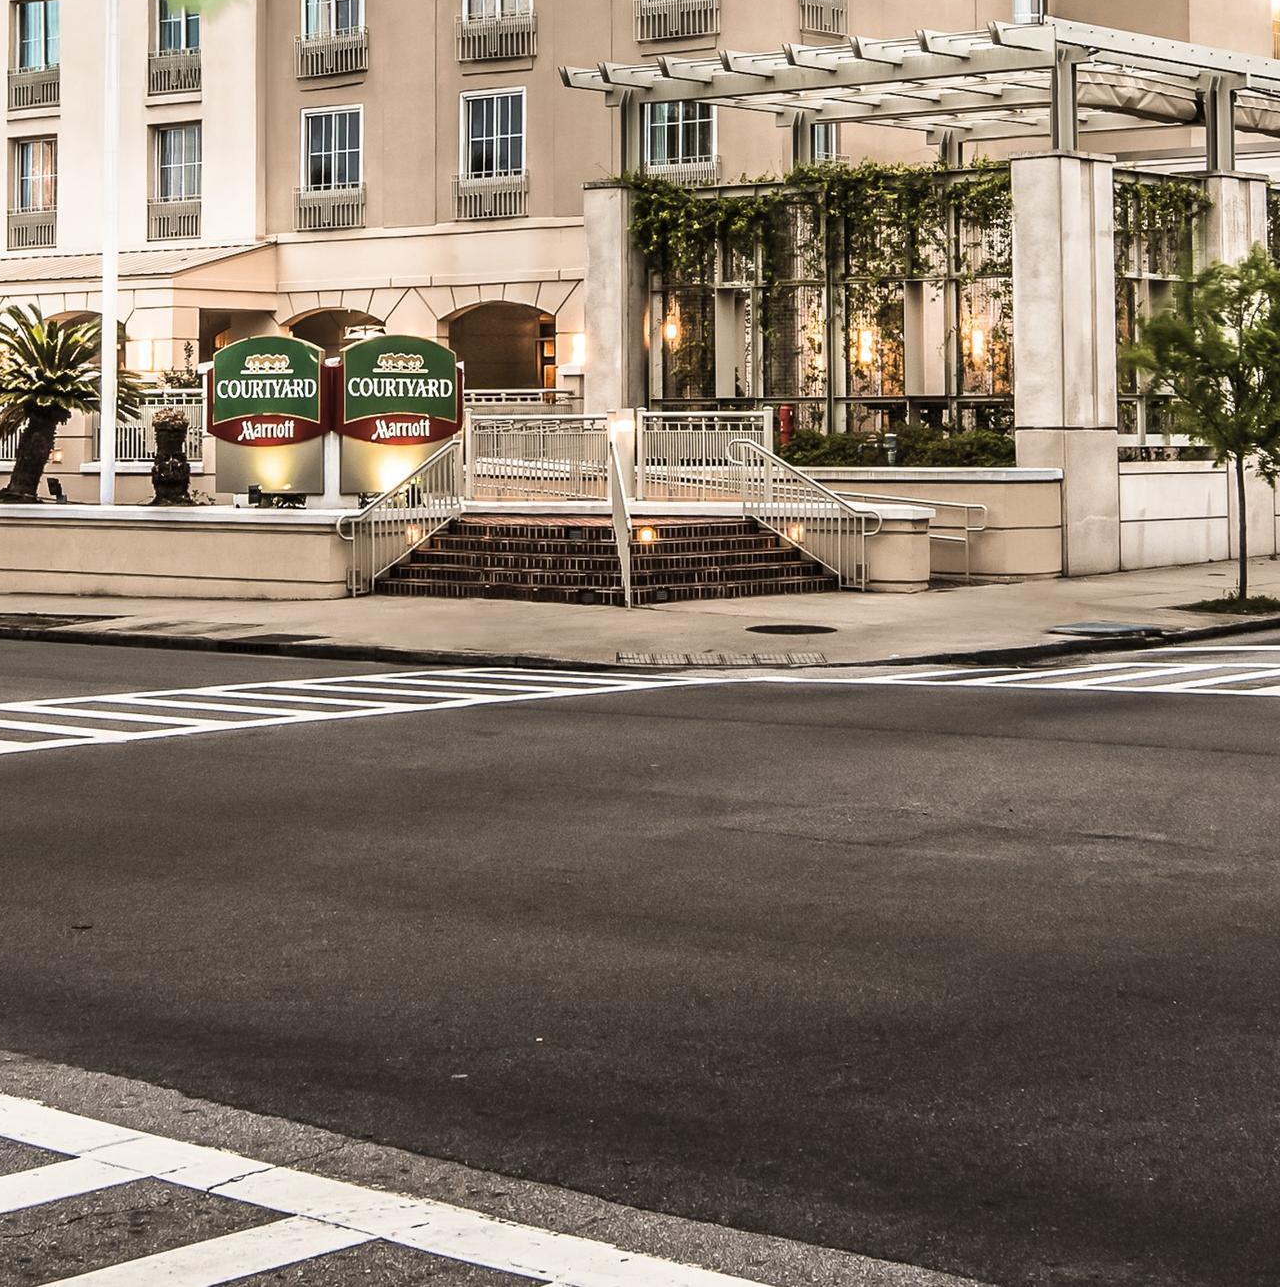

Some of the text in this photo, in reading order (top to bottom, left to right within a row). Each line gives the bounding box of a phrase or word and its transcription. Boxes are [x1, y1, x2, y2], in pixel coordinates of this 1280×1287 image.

[216, 378, 317, 399] COURTYARD
[347, 377, 453, 398] COURTYARD
[237, 420, 295, 441] Marriott
[370, 418, 431, 441] Marriott
